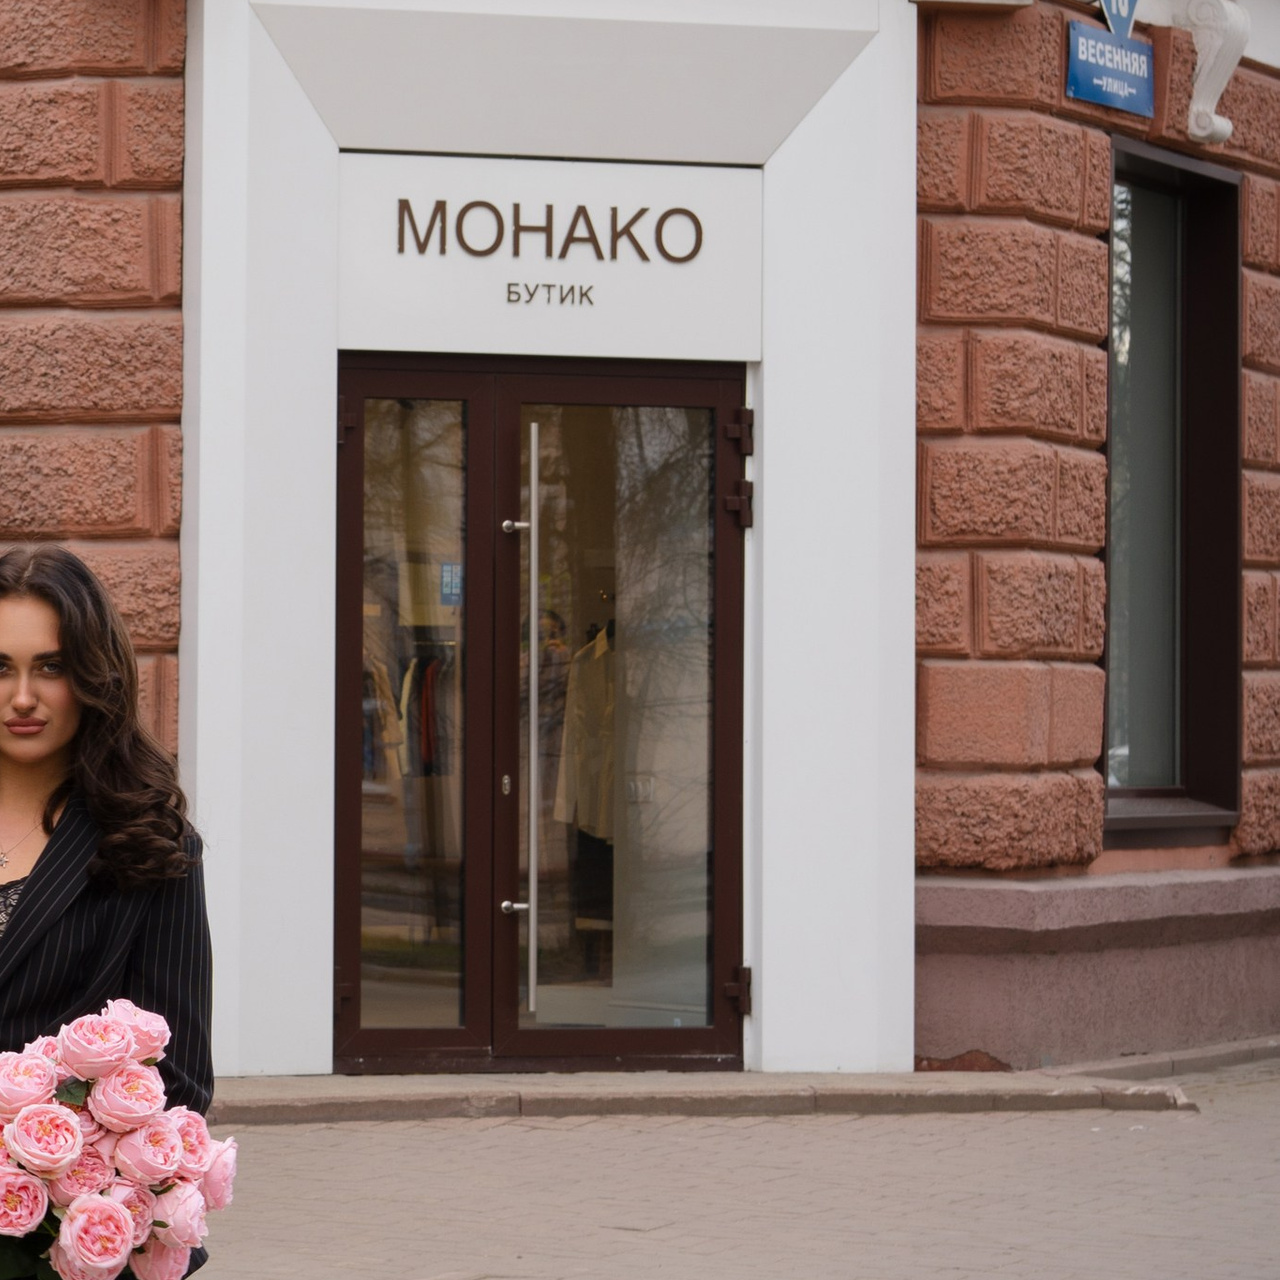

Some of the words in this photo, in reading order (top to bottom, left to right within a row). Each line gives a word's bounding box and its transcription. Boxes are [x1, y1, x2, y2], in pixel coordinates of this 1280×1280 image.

[1078, 36, 1147, 78] ВЕСЕННЯЯ
[397, 198, 703, 264] МОНАКО
[506, 283, 594, 305] БУТИК
